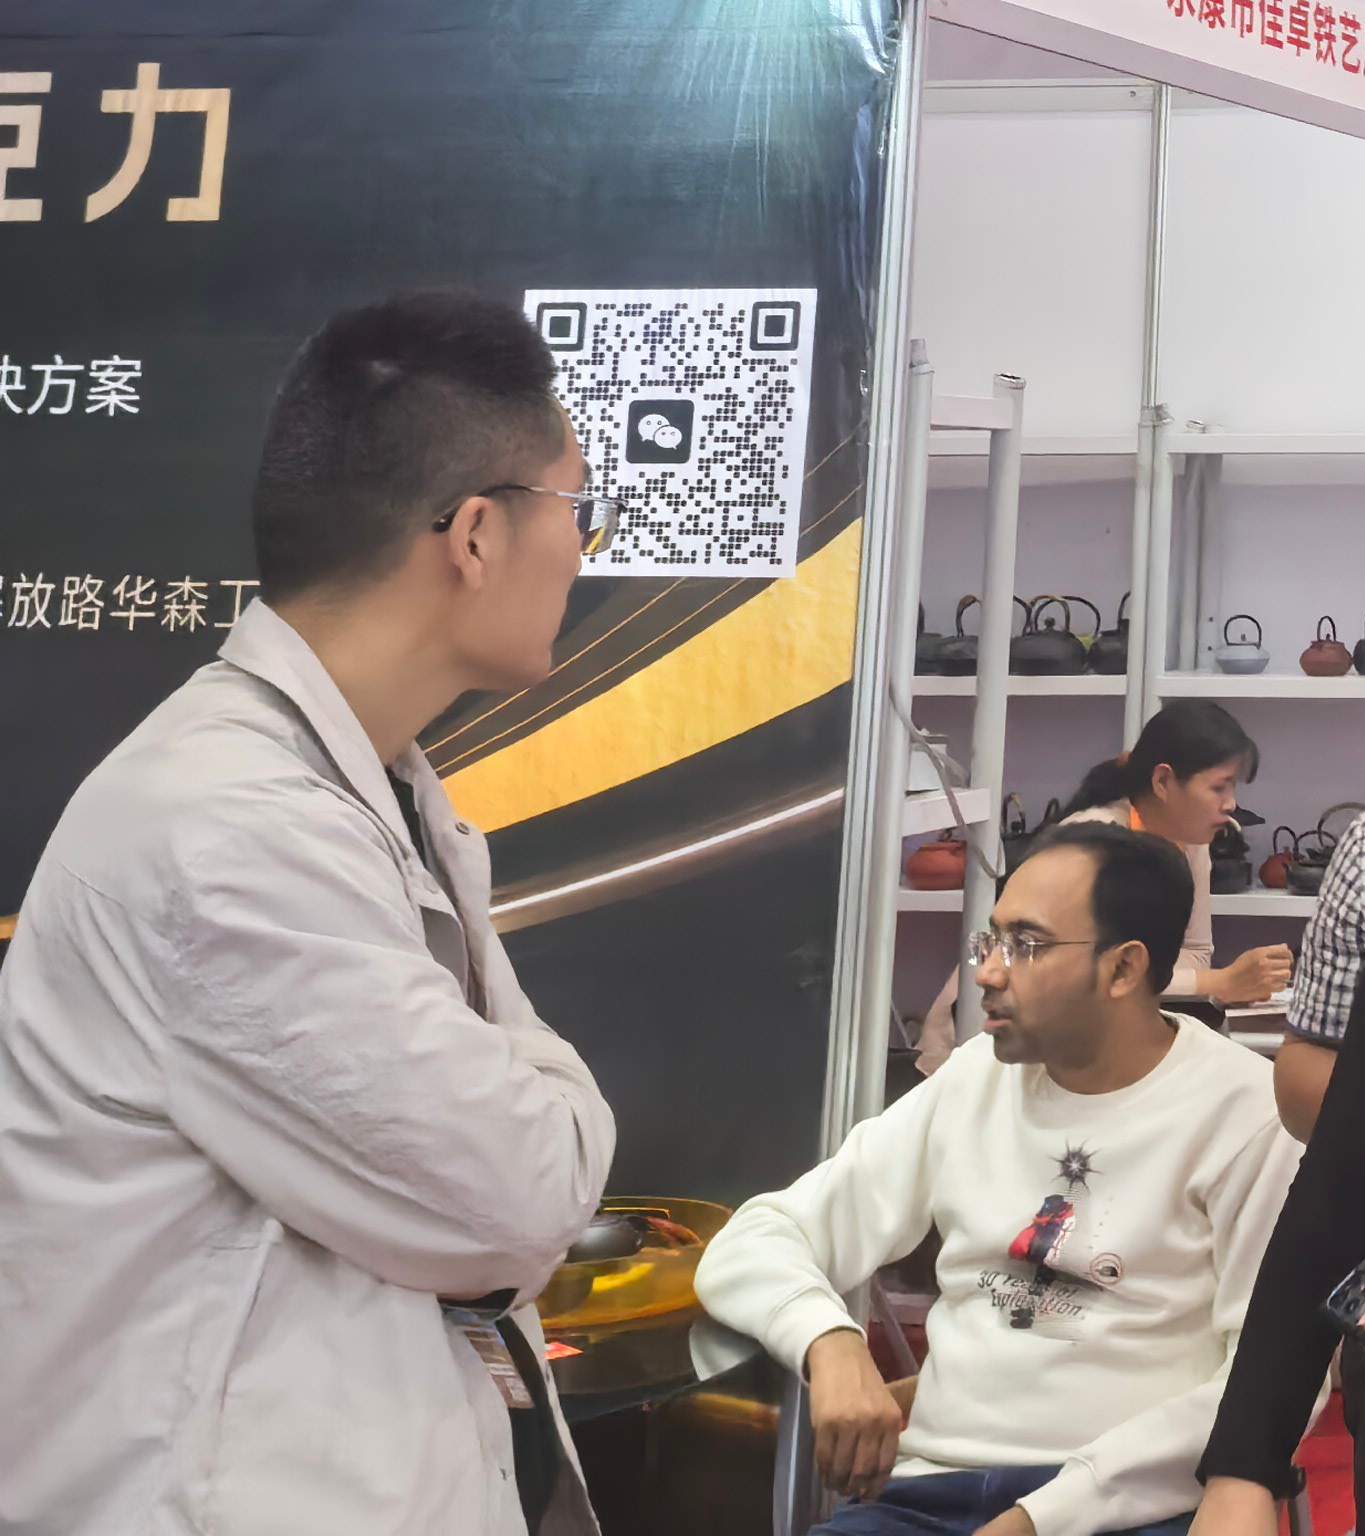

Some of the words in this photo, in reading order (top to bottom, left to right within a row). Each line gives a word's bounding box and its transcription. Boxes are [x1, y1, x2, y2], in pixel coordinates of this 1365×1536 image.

[0, 355, 143, 417] 方案
[0, 574, 261, 633] 放路华森工
